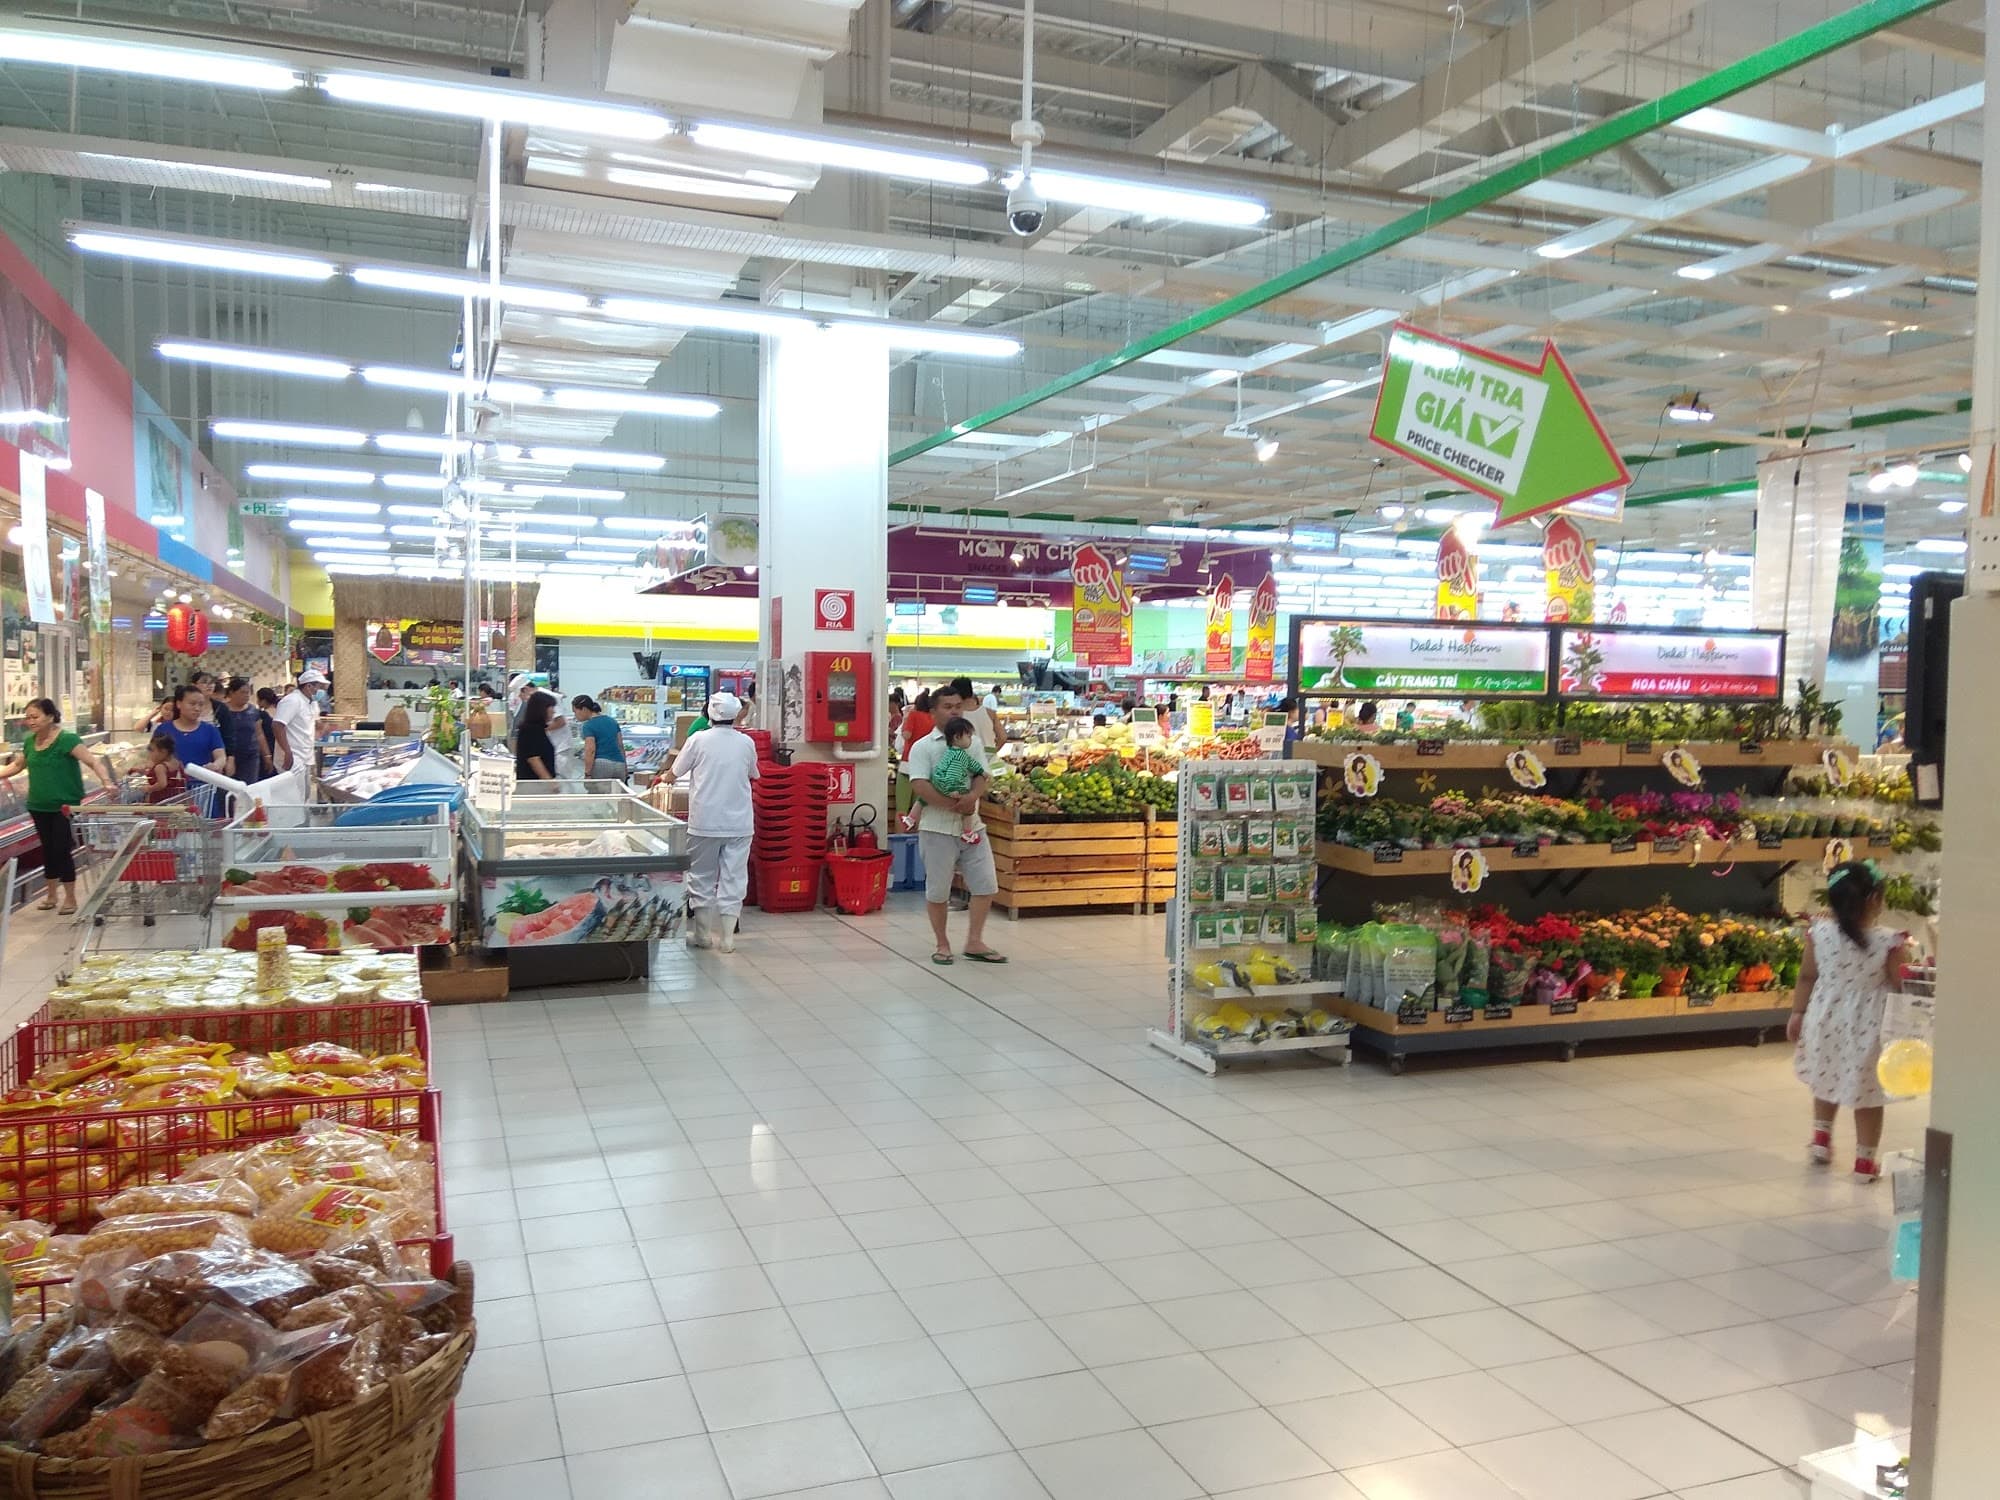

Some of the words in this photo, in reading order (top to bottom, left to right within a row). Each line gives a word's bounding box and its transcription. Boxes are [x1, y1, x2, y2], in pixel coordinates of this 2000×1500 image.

[1480, 375, 1524, 412] TRA
[1415, 391, 1465, 440] GIÁ
[1406, 429, 1442, 455] PRICE
[1443, 447, 1505, 484] CHECKER
[825, 620, 844, 628] RIA
[830, 656, 852, 672] 40
[1375, 671, 1400, 688] CÂY
[1400, 674, 1438, 688] TRANG
[1440, 672, 1459, 688] TRÍ
[1632, 678, 1656, 690] HOA
